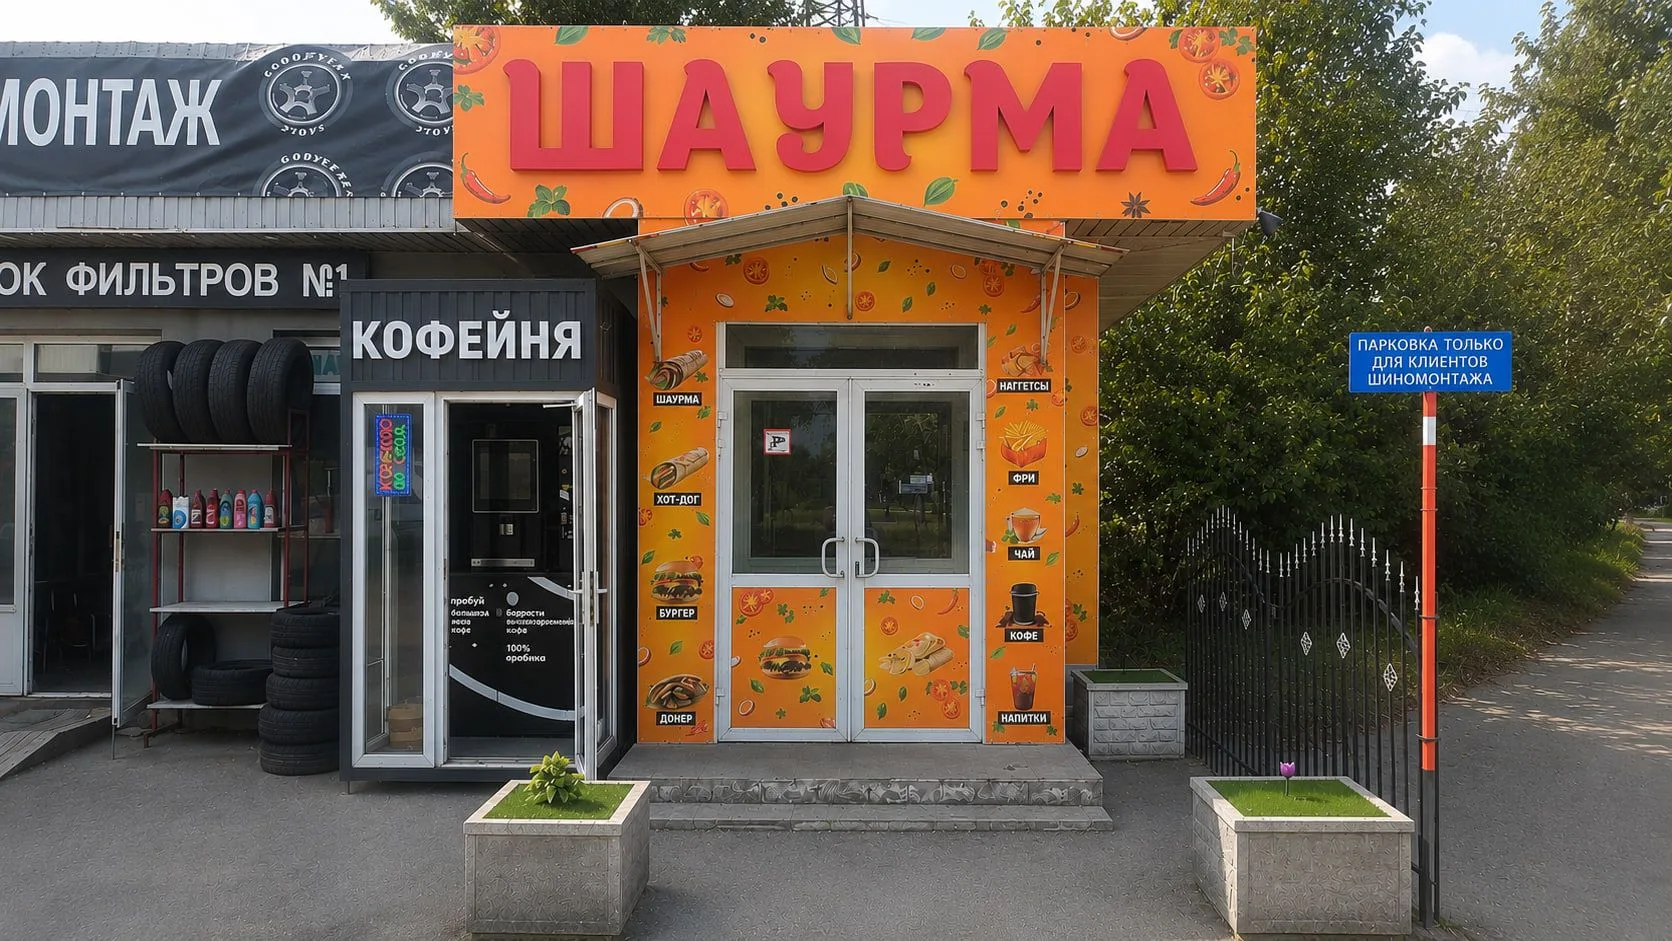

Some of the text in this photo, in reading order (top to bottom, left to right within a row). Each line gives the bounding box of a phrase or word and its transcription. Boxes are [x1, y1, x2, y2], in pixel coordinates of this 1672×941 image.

[503, 58, 1200, 180] ШАУРМА
[66, 262, 279, 296] ФИЛЬТРОВ
[352, 310, 581, 360] КОФЕЙНЯ
[1358, 338, 1504, 351] ПАРКОВКА ТОЛЬКО
[1372, 356, 1488, 371] ДЛЯ КЛИЕНТОВ
[1368, 373, 1493, 386] ШИНОМОНТАЖА
[999, 381, 1049, 391] НАГГЕТСЫ
[656, 394, 700, 405] ШАУРМА
[1012, 473, 1035, 484] ФРИ
[656, 494, 700, 505] ХОТ-ДОГ
[1014, 547, 1035, 559] ЧАЙ
[450, 595, 485, 607] пробуй
[659, 608, 695, 618] БУРГЕР
[1010, 630, 1038, 641] КОФЕ
[507, 644, 531, 653] 100%
[660, 714, 693, 725] ДОНЕР
[1001, 713, 1047, 724] НАПИТКИ
